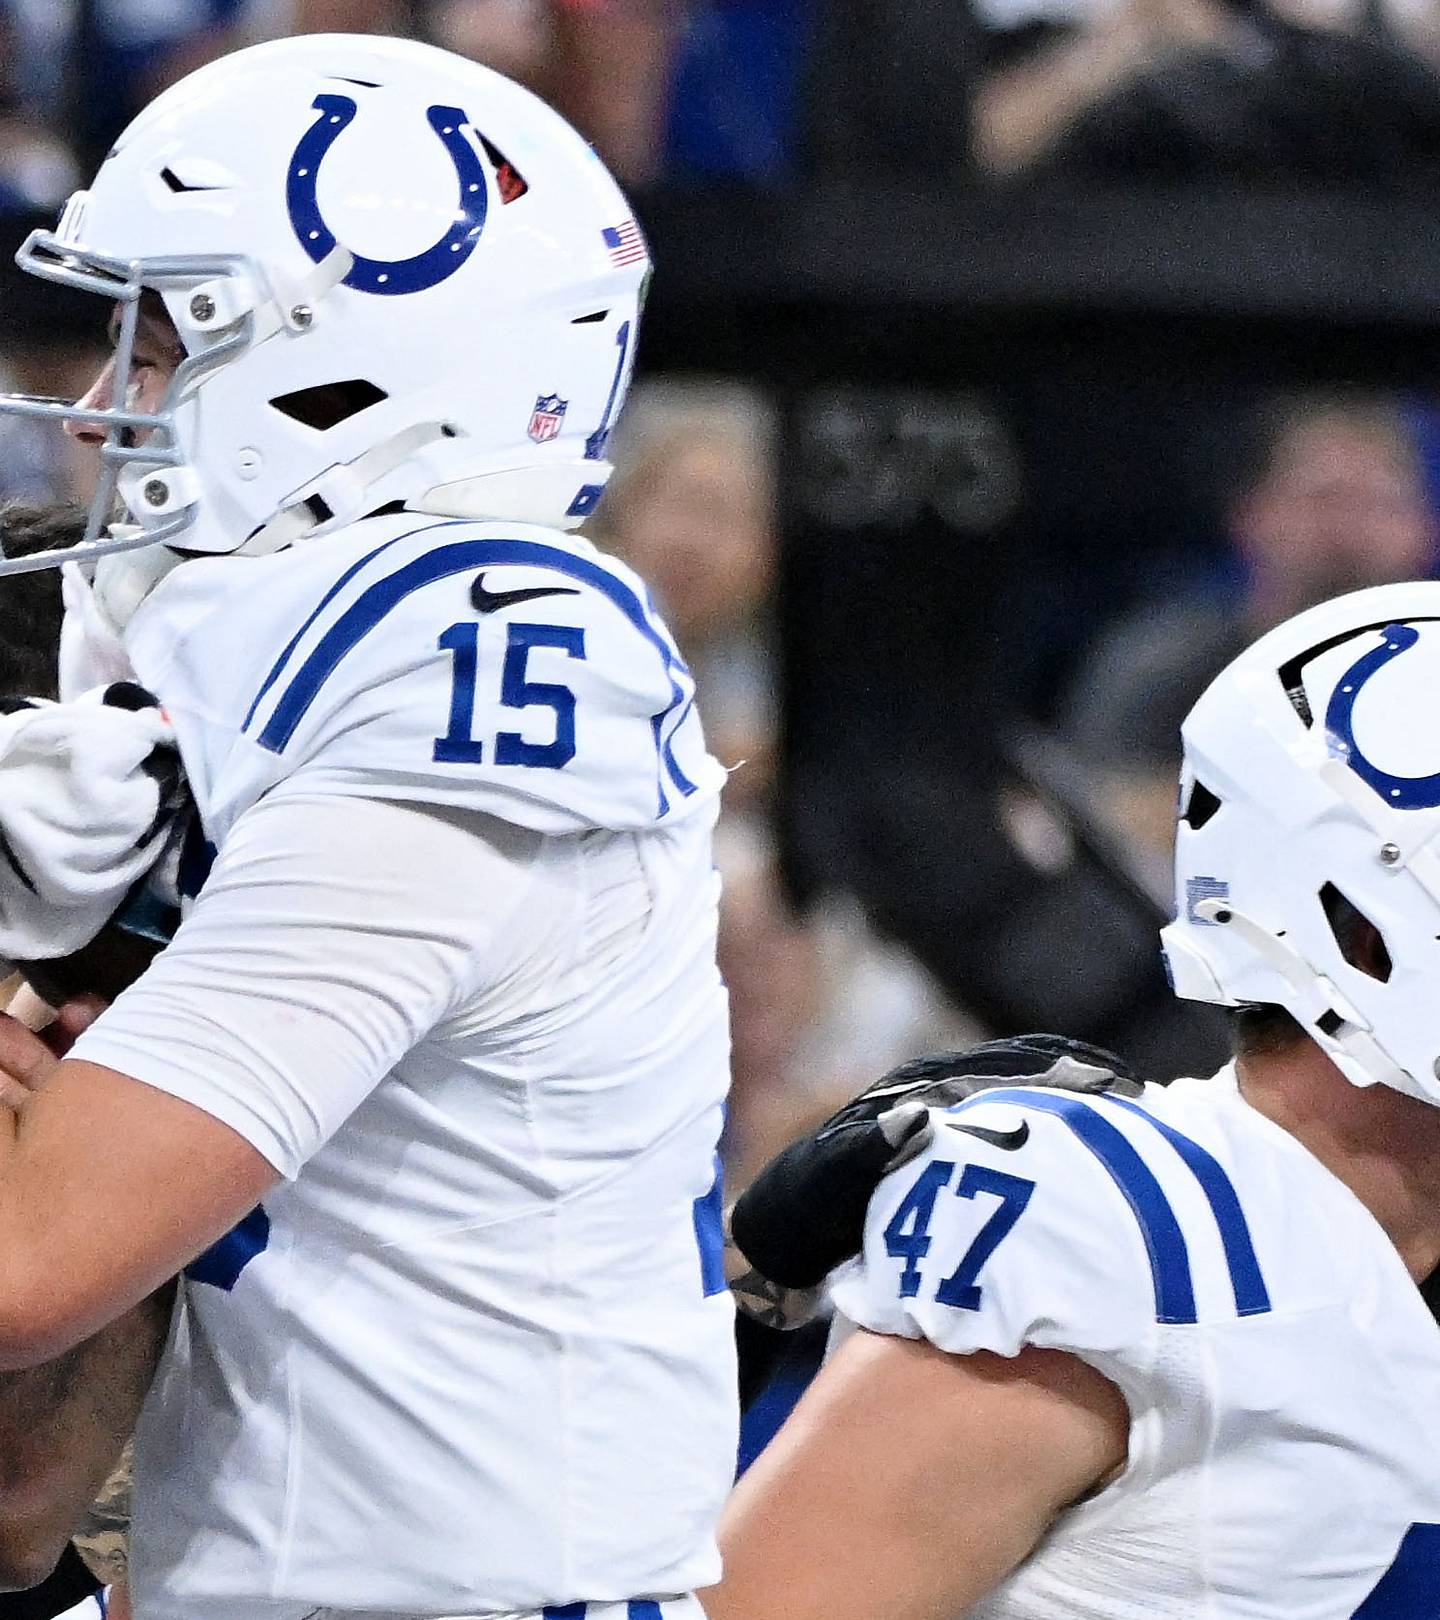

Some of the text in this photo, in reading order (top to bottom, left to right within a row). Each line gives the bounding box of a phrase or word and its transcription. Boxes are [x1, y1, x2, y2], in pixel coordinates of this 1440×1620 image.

[531, 413, 559, 440] NFL
[432, 621, 587, 770] 15
[883, 1159, 1037, 1312] 47
